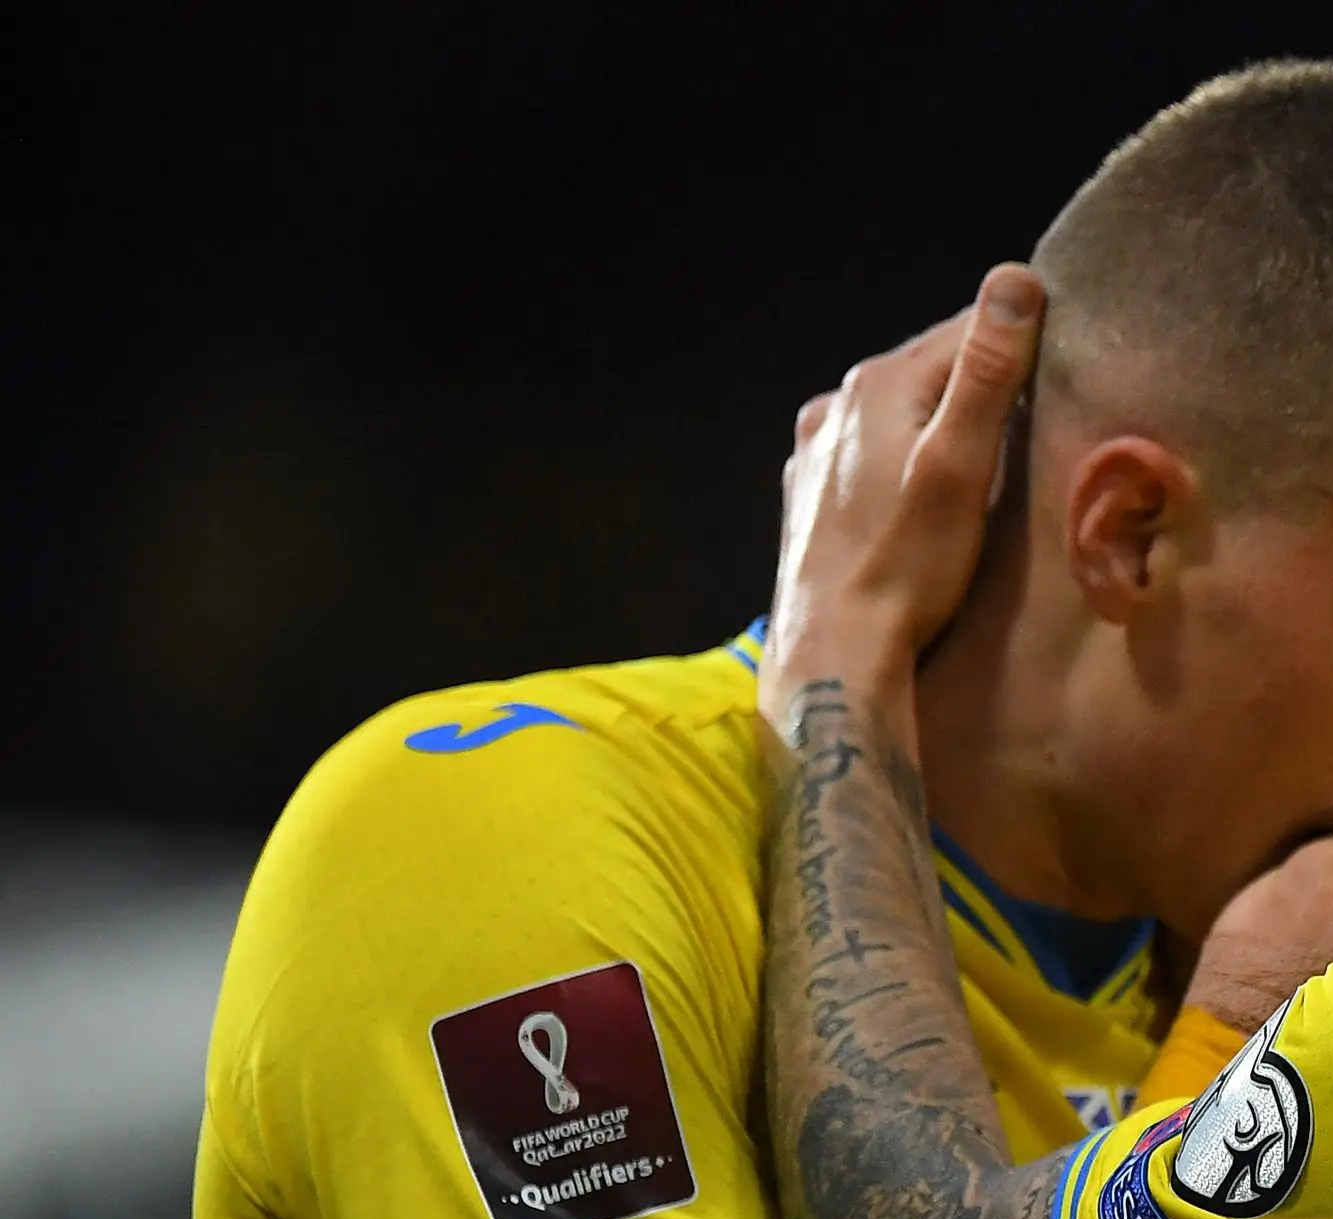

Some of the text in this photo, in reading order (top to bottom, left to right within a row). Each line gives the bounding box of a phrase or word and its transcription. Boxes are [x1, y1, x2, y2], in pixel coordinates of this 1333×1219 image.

[512, 1106, 630, 1152] FIFA WORLD CUP
[520, 1155, 653, 1210] Qualifiers
